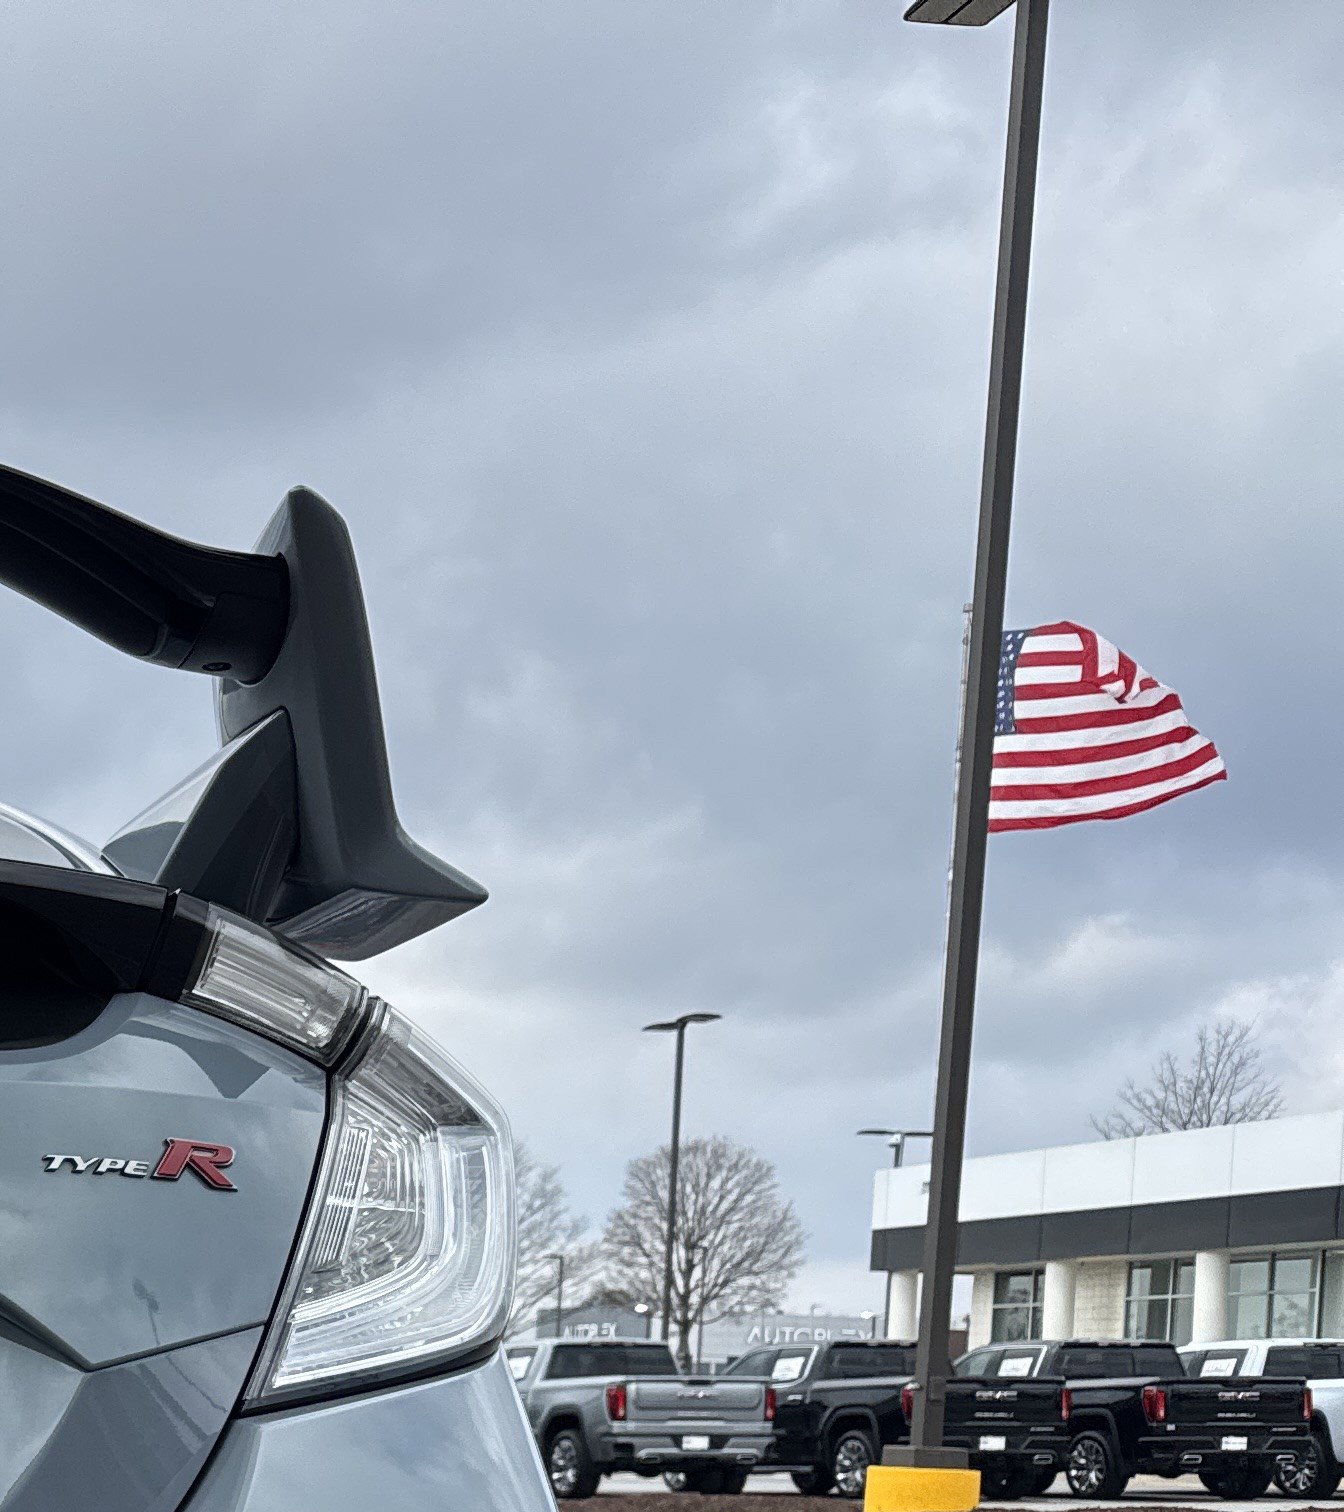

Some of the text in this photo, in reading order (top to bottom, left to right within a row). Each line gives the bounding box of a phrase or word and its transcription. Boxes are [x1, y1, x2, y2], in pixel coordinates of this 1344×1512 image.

[42, 1136, 238, 1192] TYPE R
[564, 1322, 617, 1340] AUTOPEX
